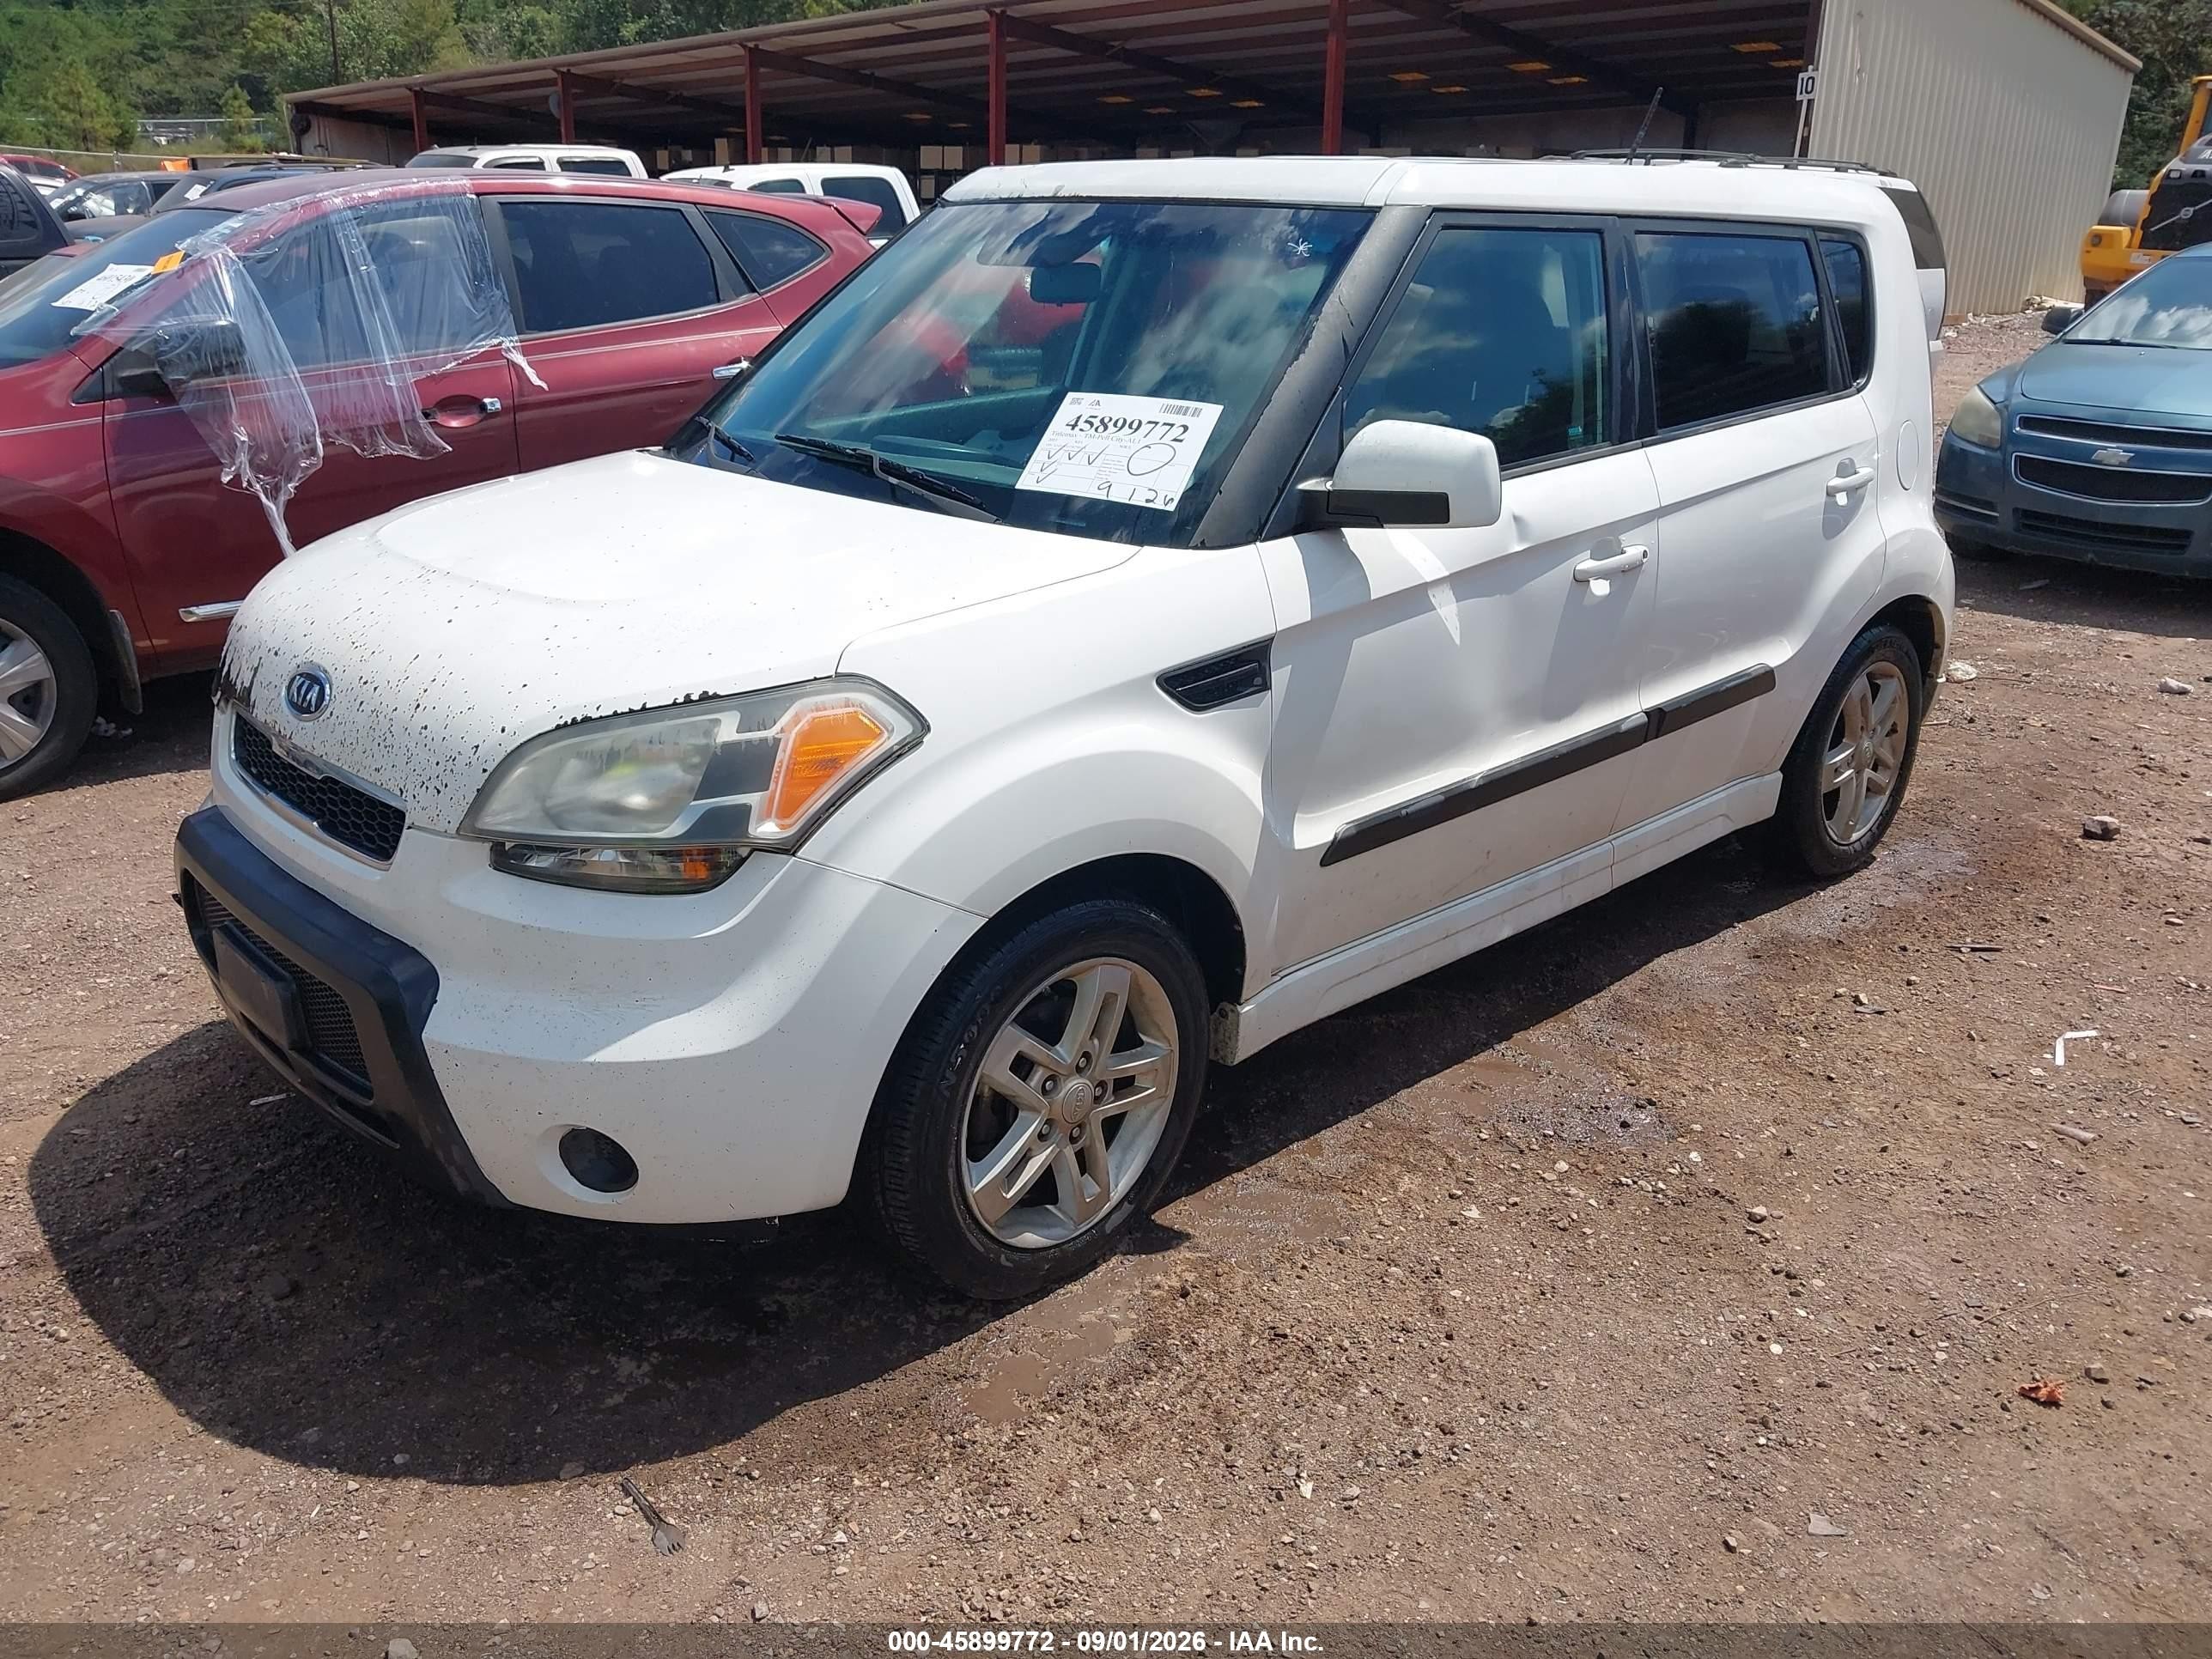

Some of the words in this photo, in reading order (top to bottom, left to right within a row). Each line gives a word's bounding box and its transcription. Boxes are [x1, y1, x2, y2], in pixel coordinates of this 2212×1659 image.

[1799, 76, 1815, 95] 10
[1066, 413, 1189, 443] 45899772
[1097, 481, 1113, 499] 9
[288, 675, 320, 712] KIA
